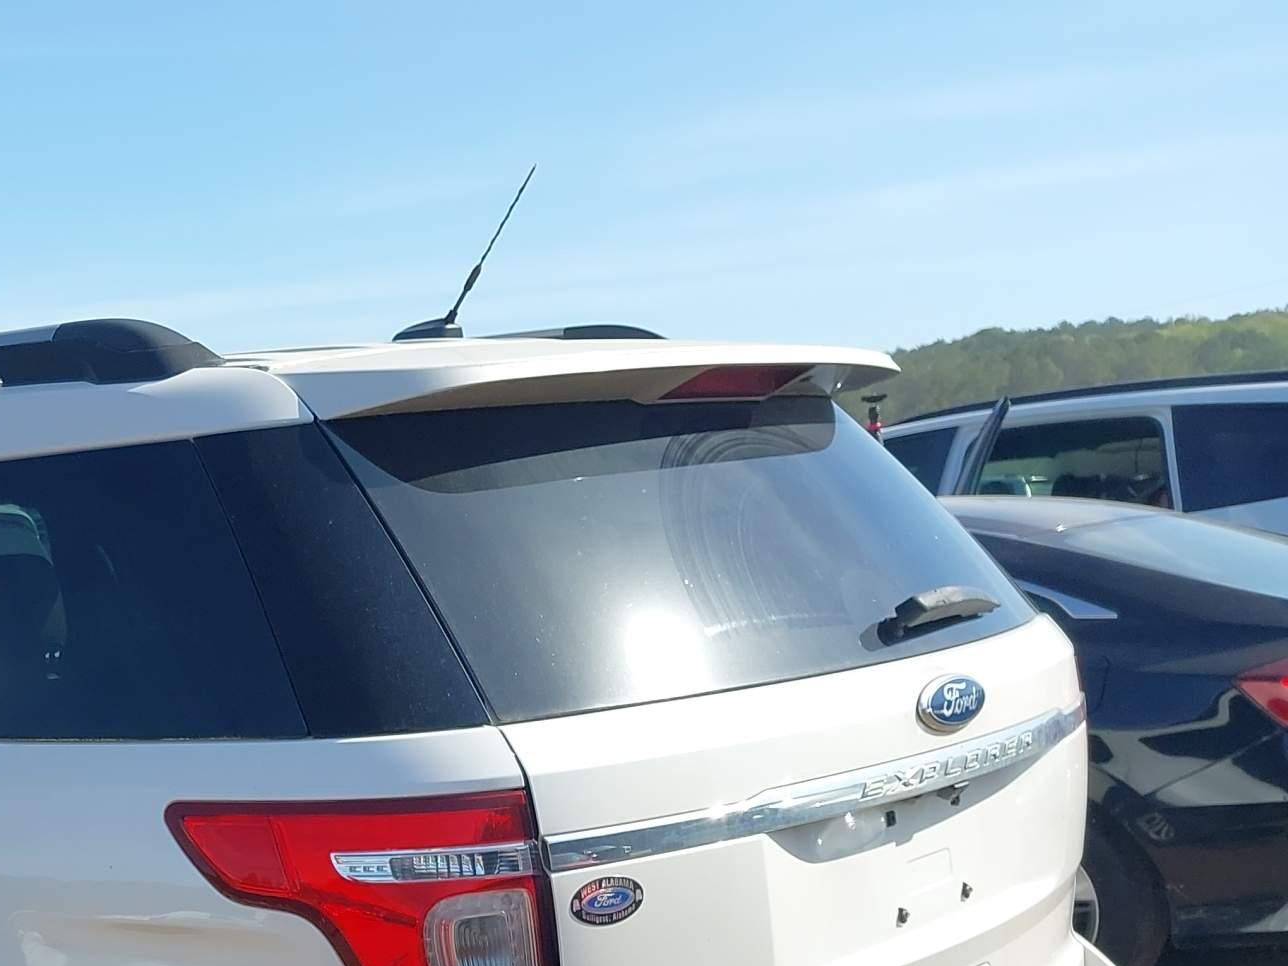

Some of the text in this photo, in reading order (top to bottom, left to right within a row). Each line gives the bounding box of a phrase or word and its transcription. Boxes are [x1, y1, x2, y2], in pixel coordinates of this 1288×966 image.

[934, 681, 978, 717] Ford
[860, 730, 1033, 799] EXPLORER
[580, 877, 634, 898] WEST ALABAMA
[594, 892, 622, 908] Ford
